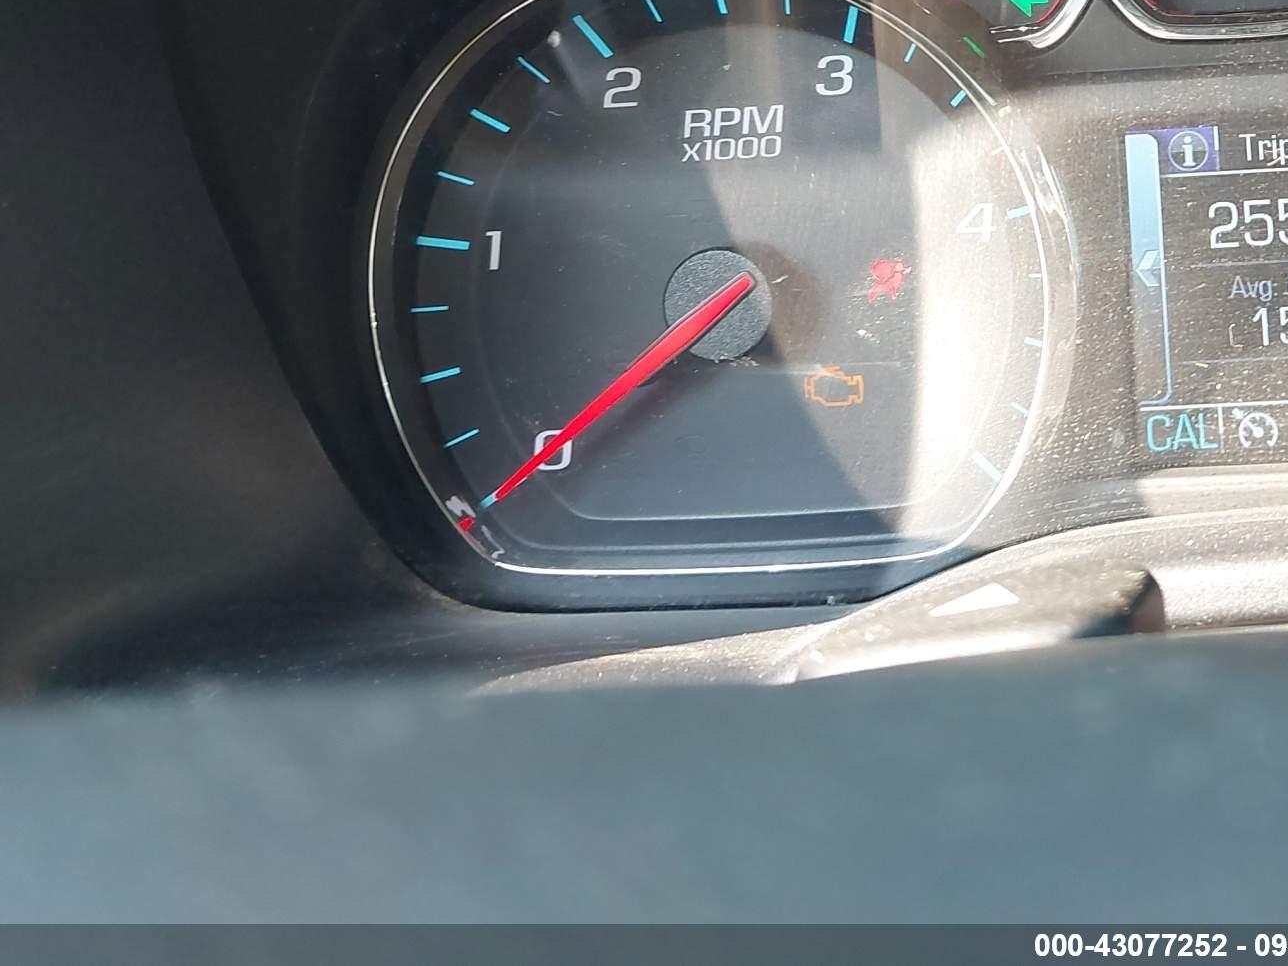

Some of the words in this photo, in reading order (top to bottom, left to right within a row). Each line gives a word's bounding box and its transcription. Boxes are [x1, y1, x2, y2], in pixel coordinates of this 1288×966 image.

[602, 67, 642, 109] 2
[815, 54, 854, 96] 3
[682, 104, 785, 139] RPM
[681, 135, 782, 162] x1000
[957, 201, 997, 244] 4
[485, 230, 503, 271] 1
[534, 429, 574, 471] 0
[1145, 412, 1218, 452] CAL
